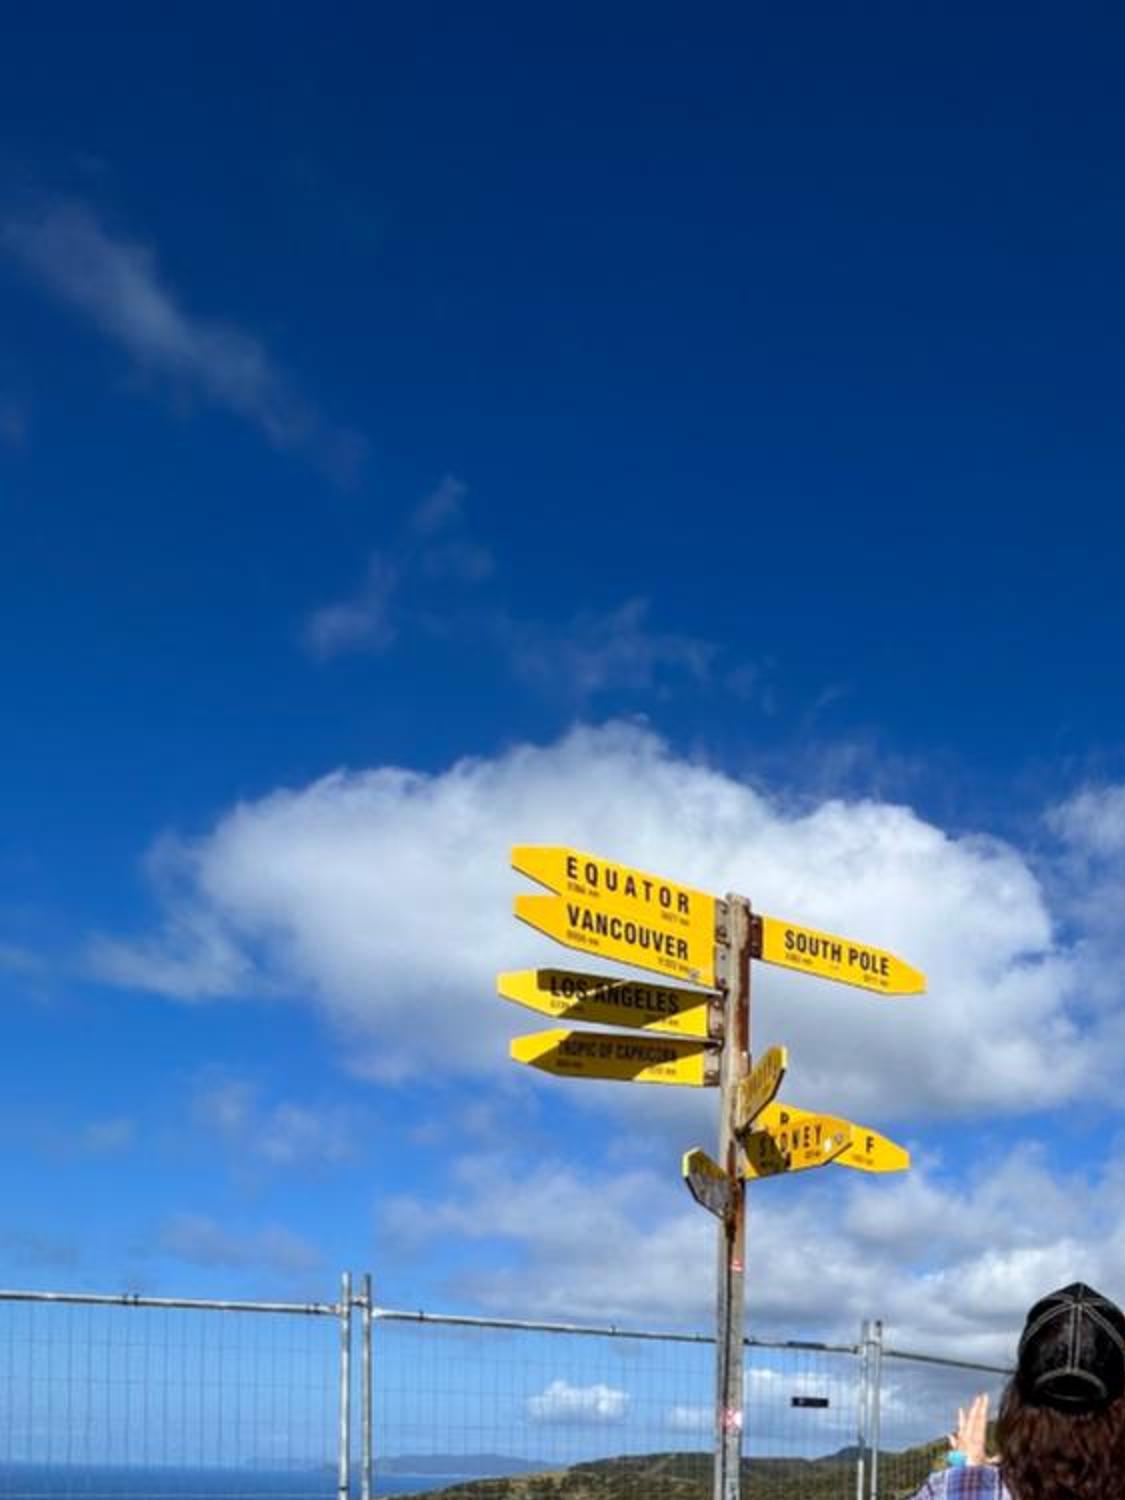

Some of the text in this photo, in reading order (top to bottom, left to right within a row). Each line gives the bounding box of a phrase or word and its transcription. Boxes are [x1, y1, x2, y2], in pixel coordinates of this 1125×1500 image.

[566, 855, 690, 914] EQUATOR
[566, 903, 689, 961] VANCOUVER
[784, 929, 890, 977] SOUTH POLE
[550, 975, 680, 1014] LOS ANGELES
